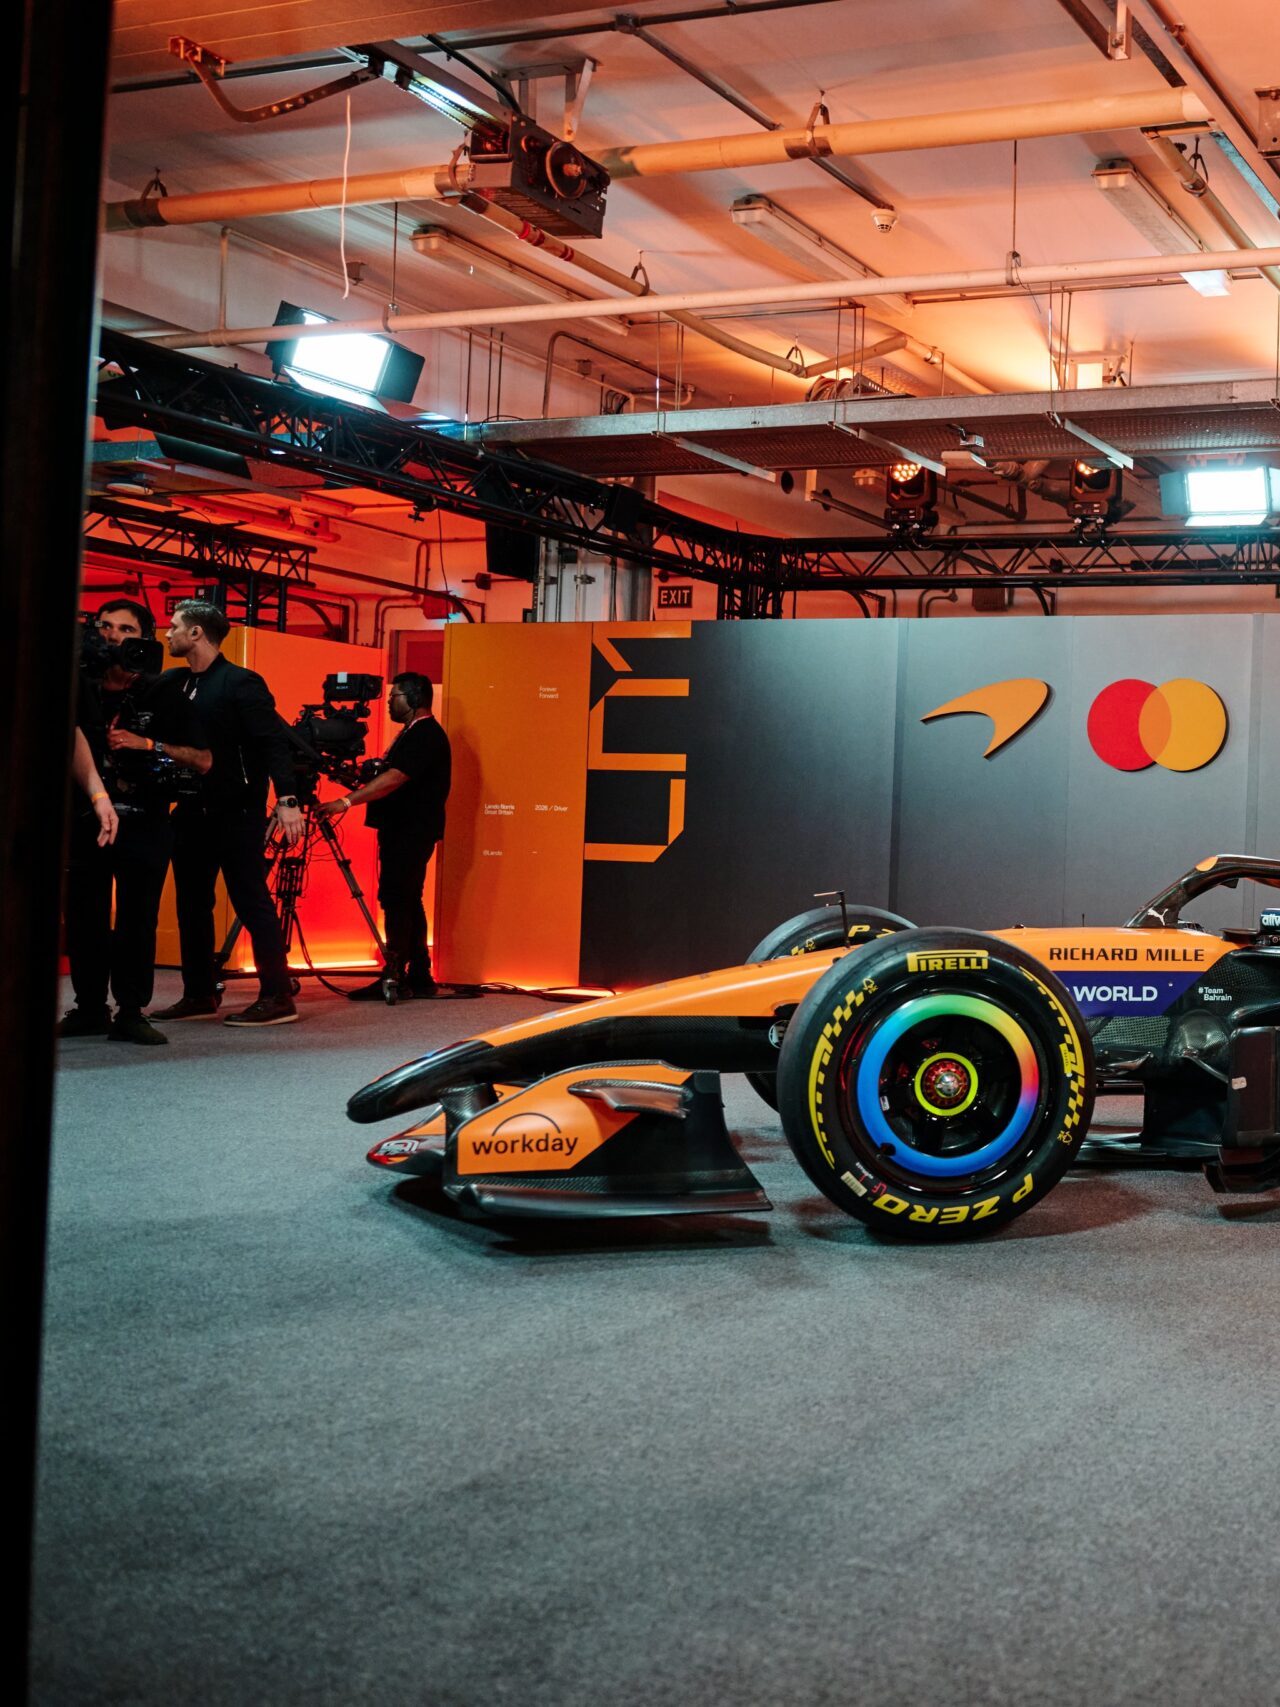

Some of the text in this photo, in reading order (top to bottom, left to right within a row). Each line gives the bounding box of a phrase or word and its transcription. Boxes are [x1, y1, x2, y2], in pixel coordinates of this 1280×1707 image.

[660, 590, 690, 605] EXIT
[848, 925, 871, 937] P
[906, 949, 989, 972] PIRELLI
[1049, 947, 1205, 962] RICHARD MILLE
[1073, 986, 1158, 1002] WORLD
[472, 1133, 579, 1156] workday
[872, 1173, 1034, 1225] P ZERO
